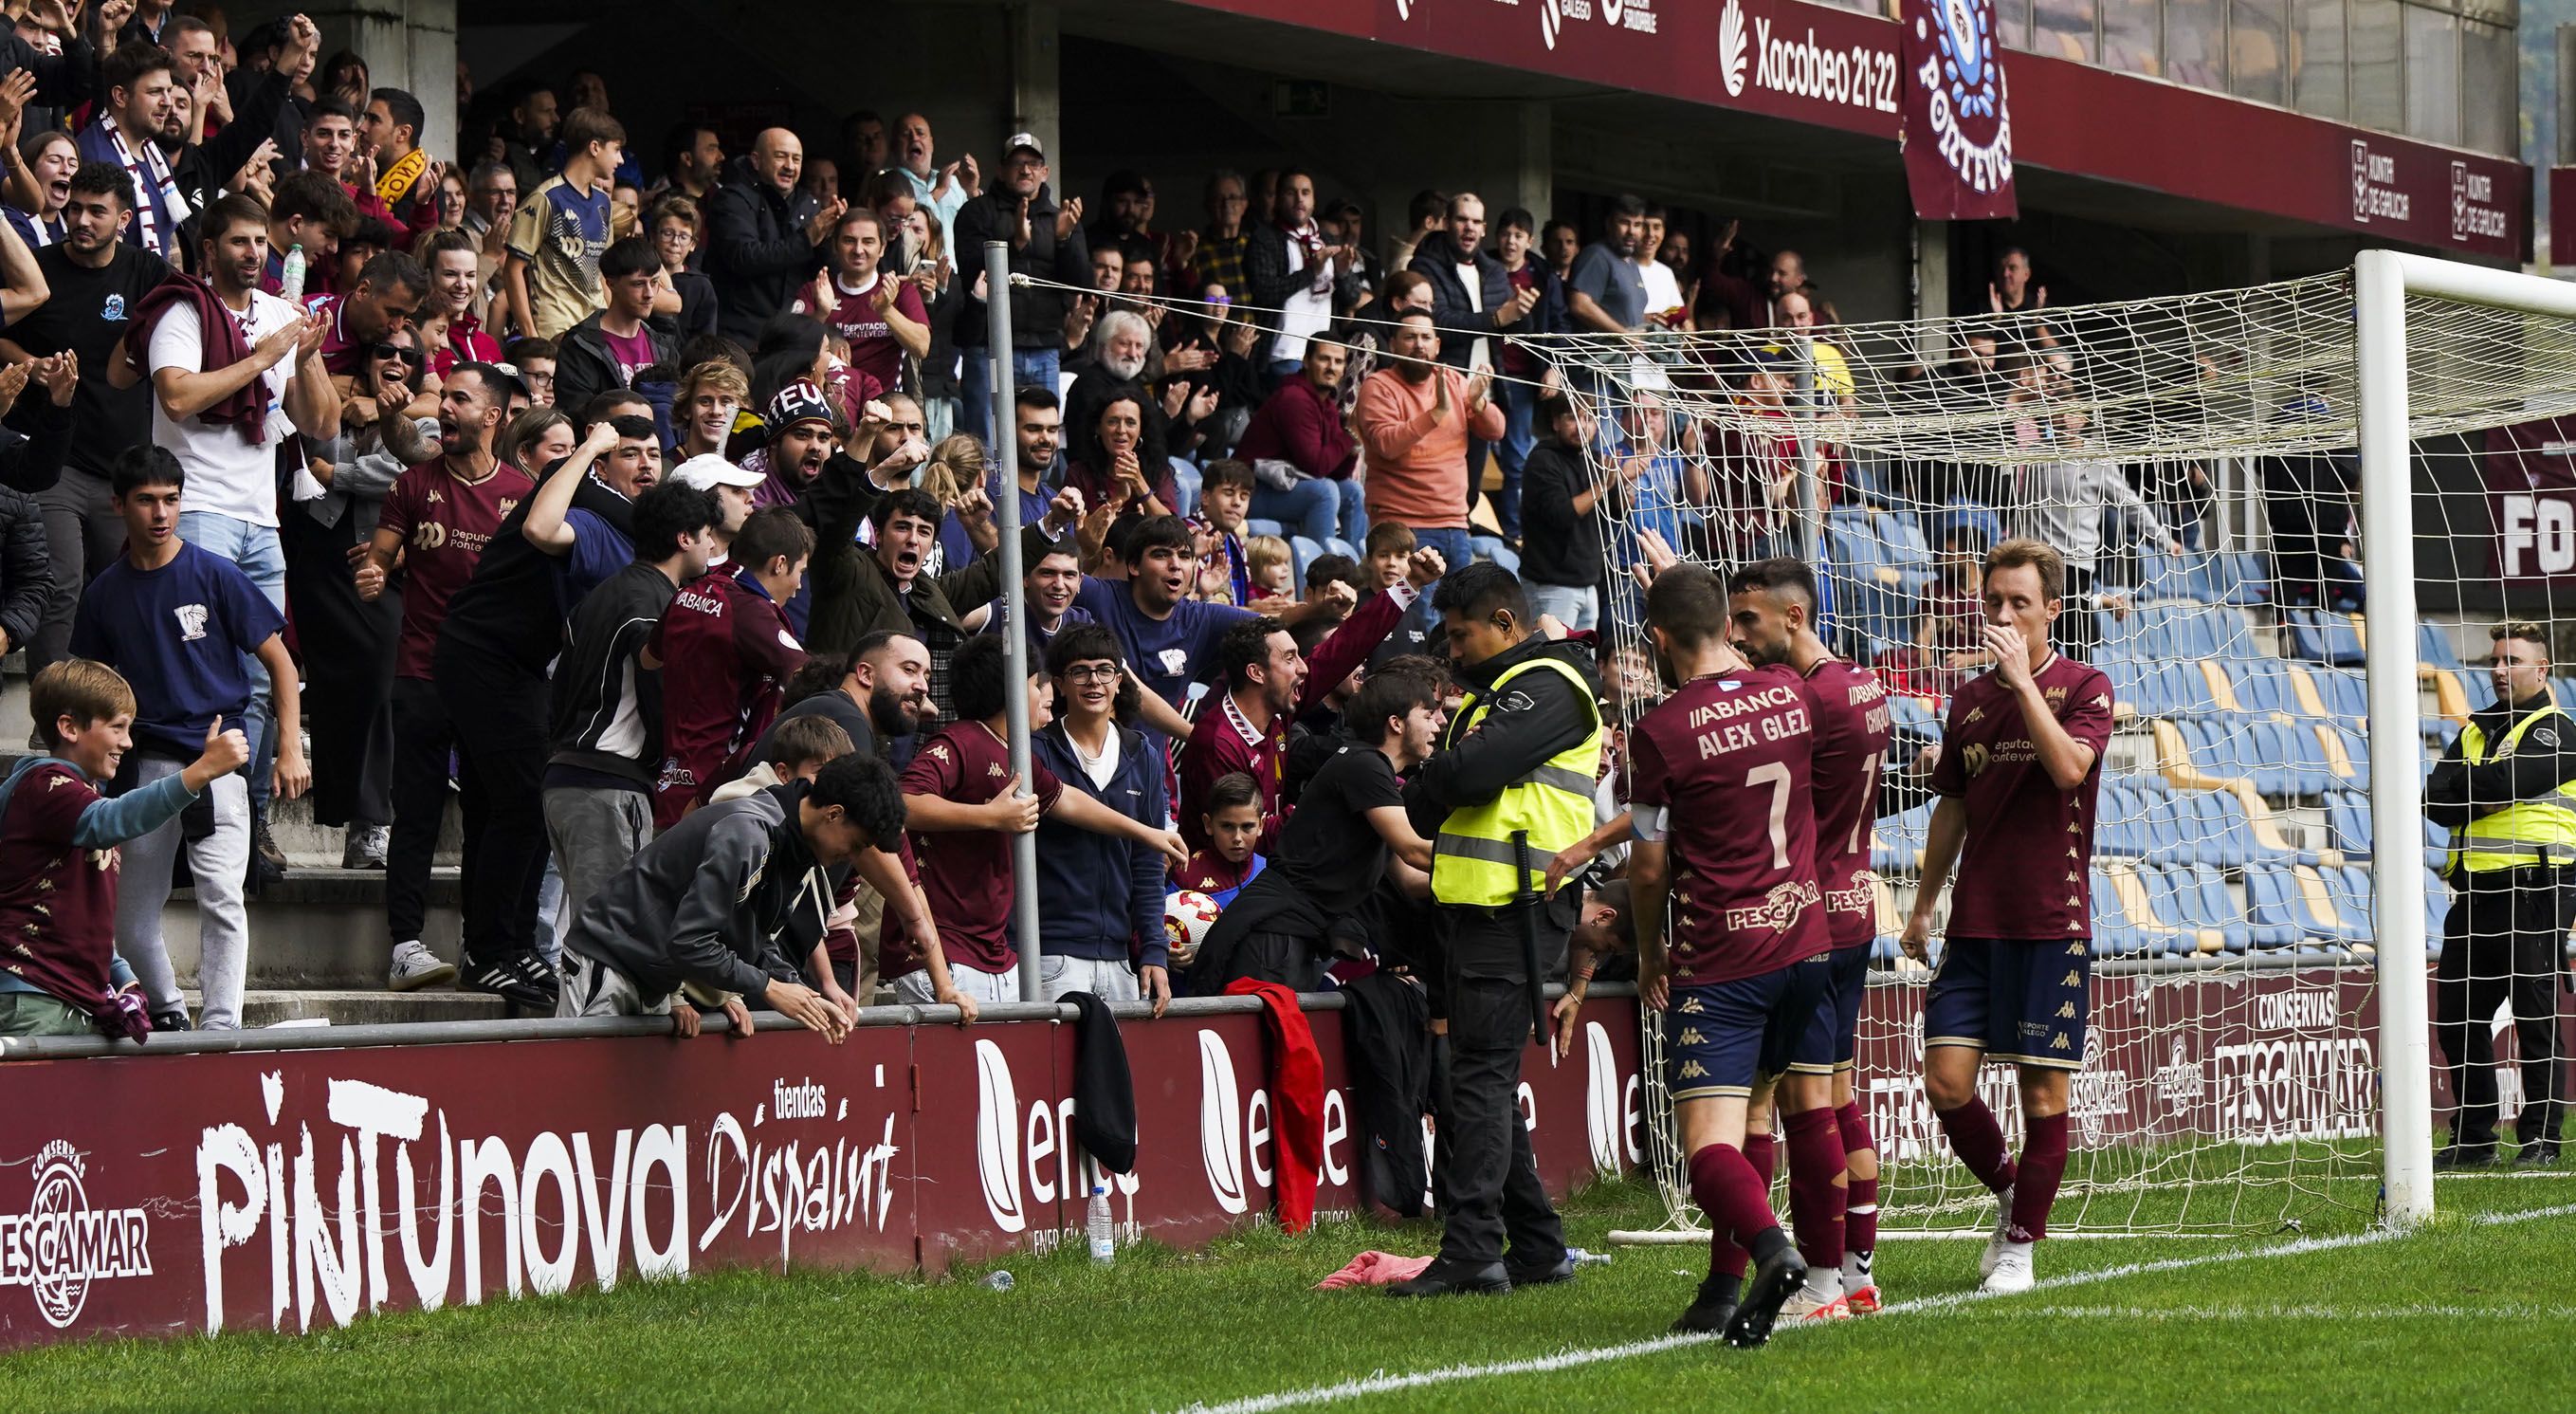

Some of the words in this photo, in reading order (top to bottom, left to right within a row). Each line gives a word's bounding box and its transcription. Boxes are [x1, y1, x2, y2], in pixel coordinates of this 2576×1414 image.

[1755, 16, 1849, 104] Xacobeo
[2367, 154, 2395, 184] XUNTA
[2466, 174, 2492, 203] XUNTA
[2368, 187, 2380, 215] DE
[2379, 190, 2410, 221] GALICIA
[2466, 206, 2477, 233] DE
[2476, 209, 2507, 238] GALICIA
[2503, 494, 2576, 578] FO
[1696, 722, 1759, 761] ALEX
[1745, 761, 1792, 871] 7
[2258, 990, 2334, 1030] CONSERVAS
[774, 1076, 827, 1119] tiendas
[2215, 1038, 2375, 1147] PESCAMAR
[32, 1139, 86, 1180] CONSERVAS
[698, 1097, 901, 1276] Dispaint
